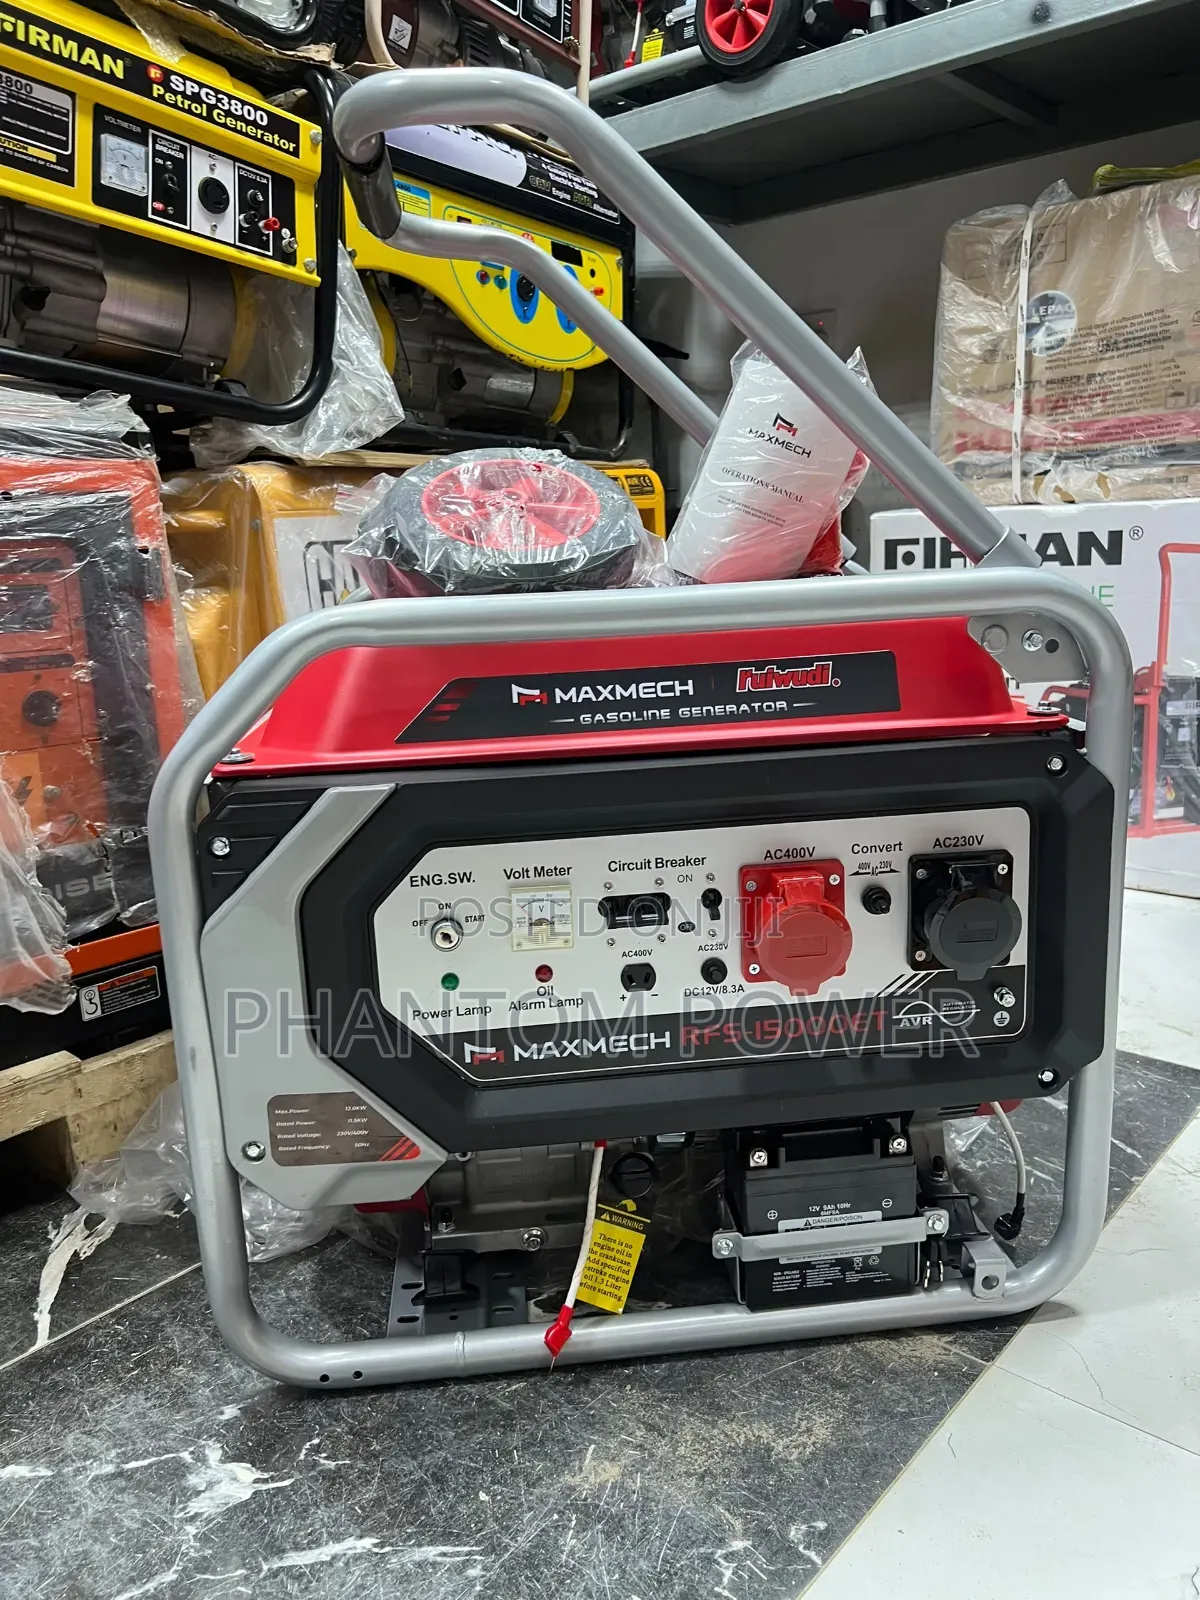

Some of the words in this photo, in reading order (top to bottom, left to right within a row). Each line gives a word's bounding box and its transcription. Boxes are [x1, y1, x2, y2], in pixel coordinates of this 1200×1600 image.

[169, 74, 268, 126] SPG3800
[152, 84, 207, 117] Petrol
[212, 108, 296, 153] Generator
[155, 143, 185, 160] BREAKER
[748, 428, 812, 459] MAXMECH
[721, 466, 770, 490] OPERATIONS
[770, 483, 804, 504] MANUAL
[884, 530, 1123, 570] FIRAN
[555, 679, 694, 704] MAXMECH
[579, 708, 671, 725] GASOLINE
[678, 701, 788, 720] GENERATOR
[851, 841, 903, 854] Convert
[932, 835, 984, 849] AC230V
[763, 847, 816, 861] AC400V
[503, 866, 530, 880] Volt
[533, 864, 573, 879] Meter
[607, 859, 652, 873] Circuit
[655, 855, 707, 869] Breaker
[858, 862, 871, 870] 400V
[880, 860, 892, 869] 230V
[410, 871, 475, 887] ENG.SW.
[677, 874, 693, 883] ON
[438, 902, 452, 910] ON
[412, 919, 429, 927] OFF
[464, 914, 485, 924] START
[678, 923, 695, 932] OFF
[621, 949, 653, 958] AC400V
[697, 943, 729, 952] AC230V
[537, 985, 554, 997] Oil
[684, 984, 745, 997] DC12V/8.3A
[508, 999, 546, 1012] Alarm
[548, 996, 584, 1009] Lamp
[412, 1008, 452, 1021] Power
[456, 1005, 492, 1018] Lamp
[899, 1016, 932, 1028] AVR
[513, 1031, 671, 1062] MAXMECH
[296, 1132, 322, 1140] Voltage:
[612, 1214, 644, 1231] WARNING
[812, 1214, 863, 1225] DANGER/POISON
[599, 1233, 617, 1246] There
[593, 1241, 615, 1254] engine
[616, 1246, 625, 1255] oil
[589, 1248, 598, 1257] the
[599, 1252, 632, 1267] crankcase.
[587, 1256, 600, 1266] Add
[600, 1259, 630, 1276] specified
[584, 1273, 594, 1282] oil
[594, 1275, 604, 1285] 1.3
[605, 1281, 622, 1291] Liter
[585, 1265, 608, 1277] -stroke
[608, 1273, 630, 1285] engine
[580, 1282, 597, 1292] efore
[597, 1287, 624, 1302] starting.
